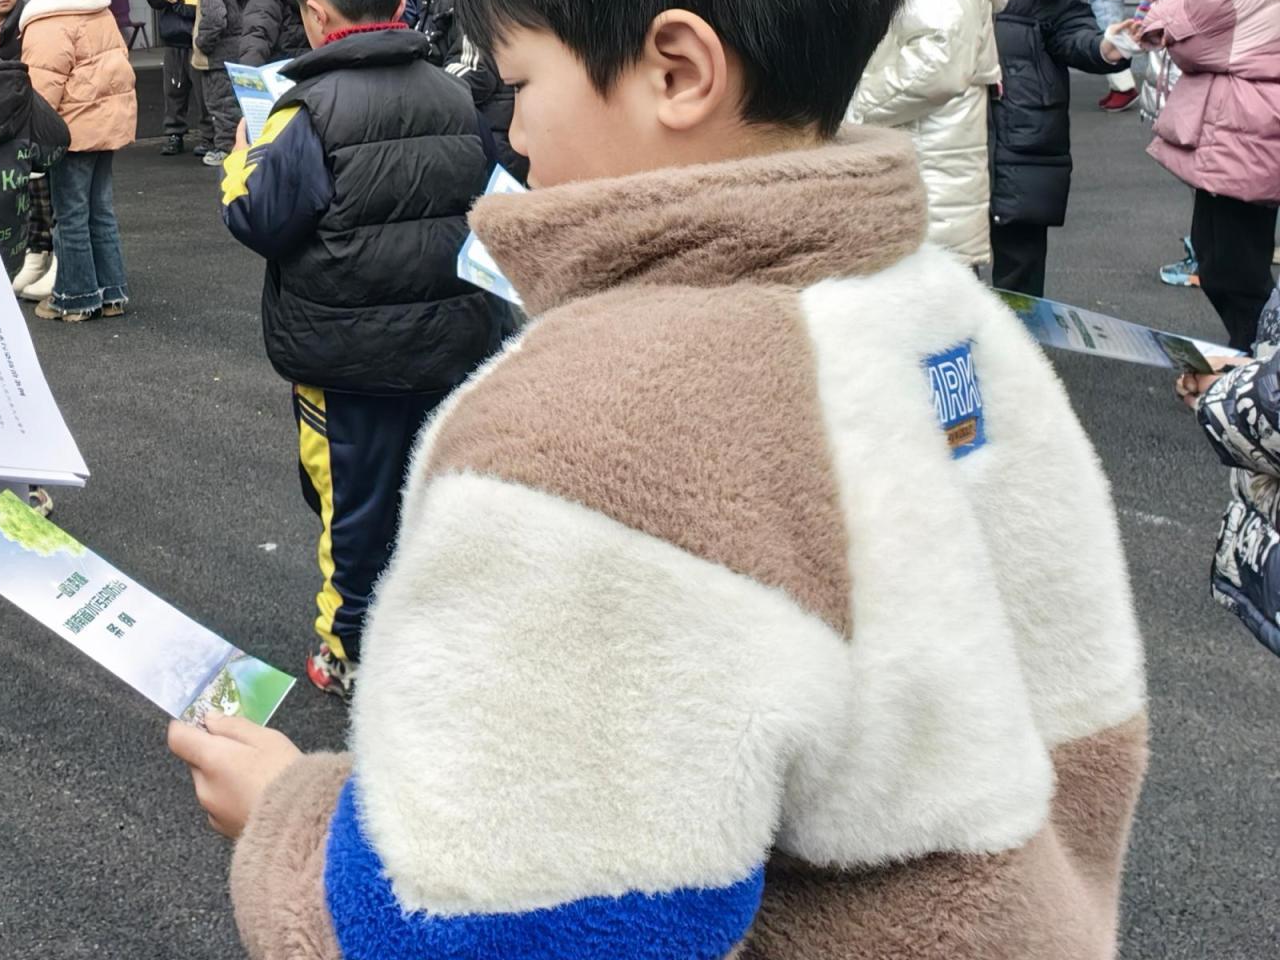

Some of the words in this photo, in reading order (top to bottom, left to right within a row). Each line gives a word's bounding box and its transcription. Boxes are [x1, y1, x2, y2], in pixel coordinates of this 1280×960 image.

[62, 580, 128, 634] 湖南省水污染防治
